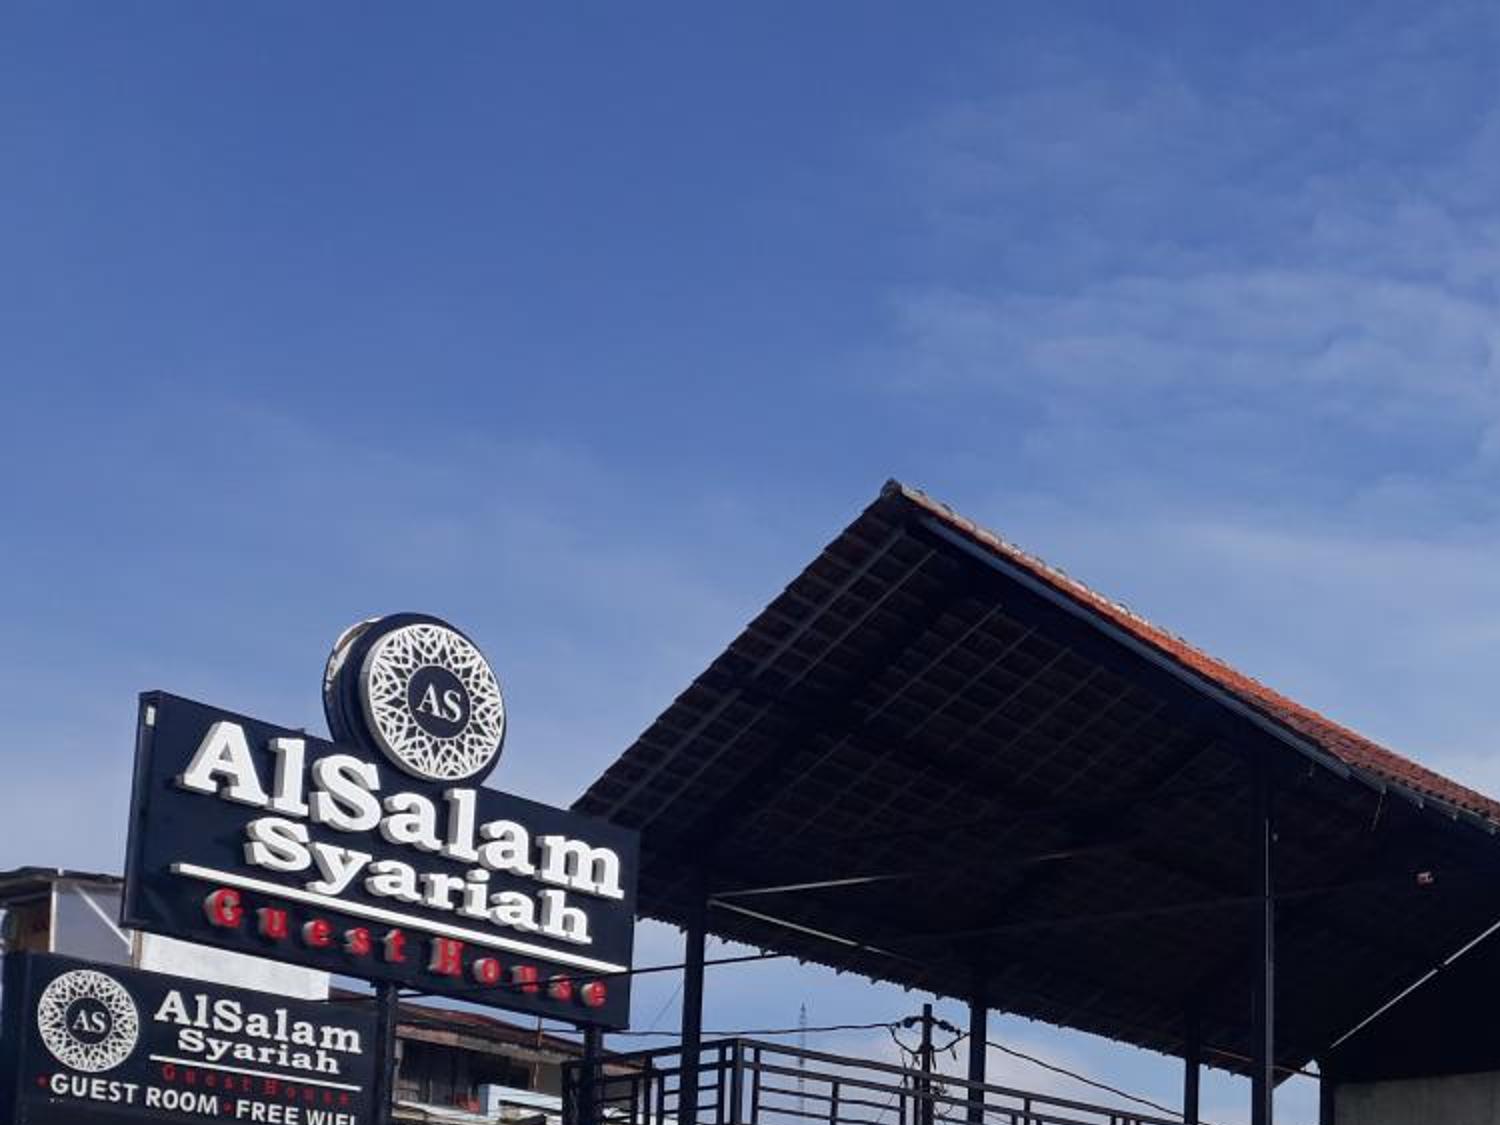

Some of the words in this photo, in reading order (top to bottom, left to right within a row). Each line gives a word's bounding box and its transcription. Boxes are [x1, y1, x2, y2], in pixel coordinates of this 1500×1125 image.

[416, 683, 461, 722] AS
[178, 720, 624, 900] AlSalam
[245, 817, 593, 944] Syariah
[205, 887, 406, 964] Guest
[431, 936, 608, 1007] House
[72, 1009, 107, 1033] AS
[154, 990, 362, 1054] AlSalam
[162, 1063, 252, 1090] Guest
[177, 1028, 340, 1074] Syariah
[50, 1073, 139, 1104] GUEST
[146, 1087, 218, 1116] ROOM
[235, 1100, 299, 1125] FREE
